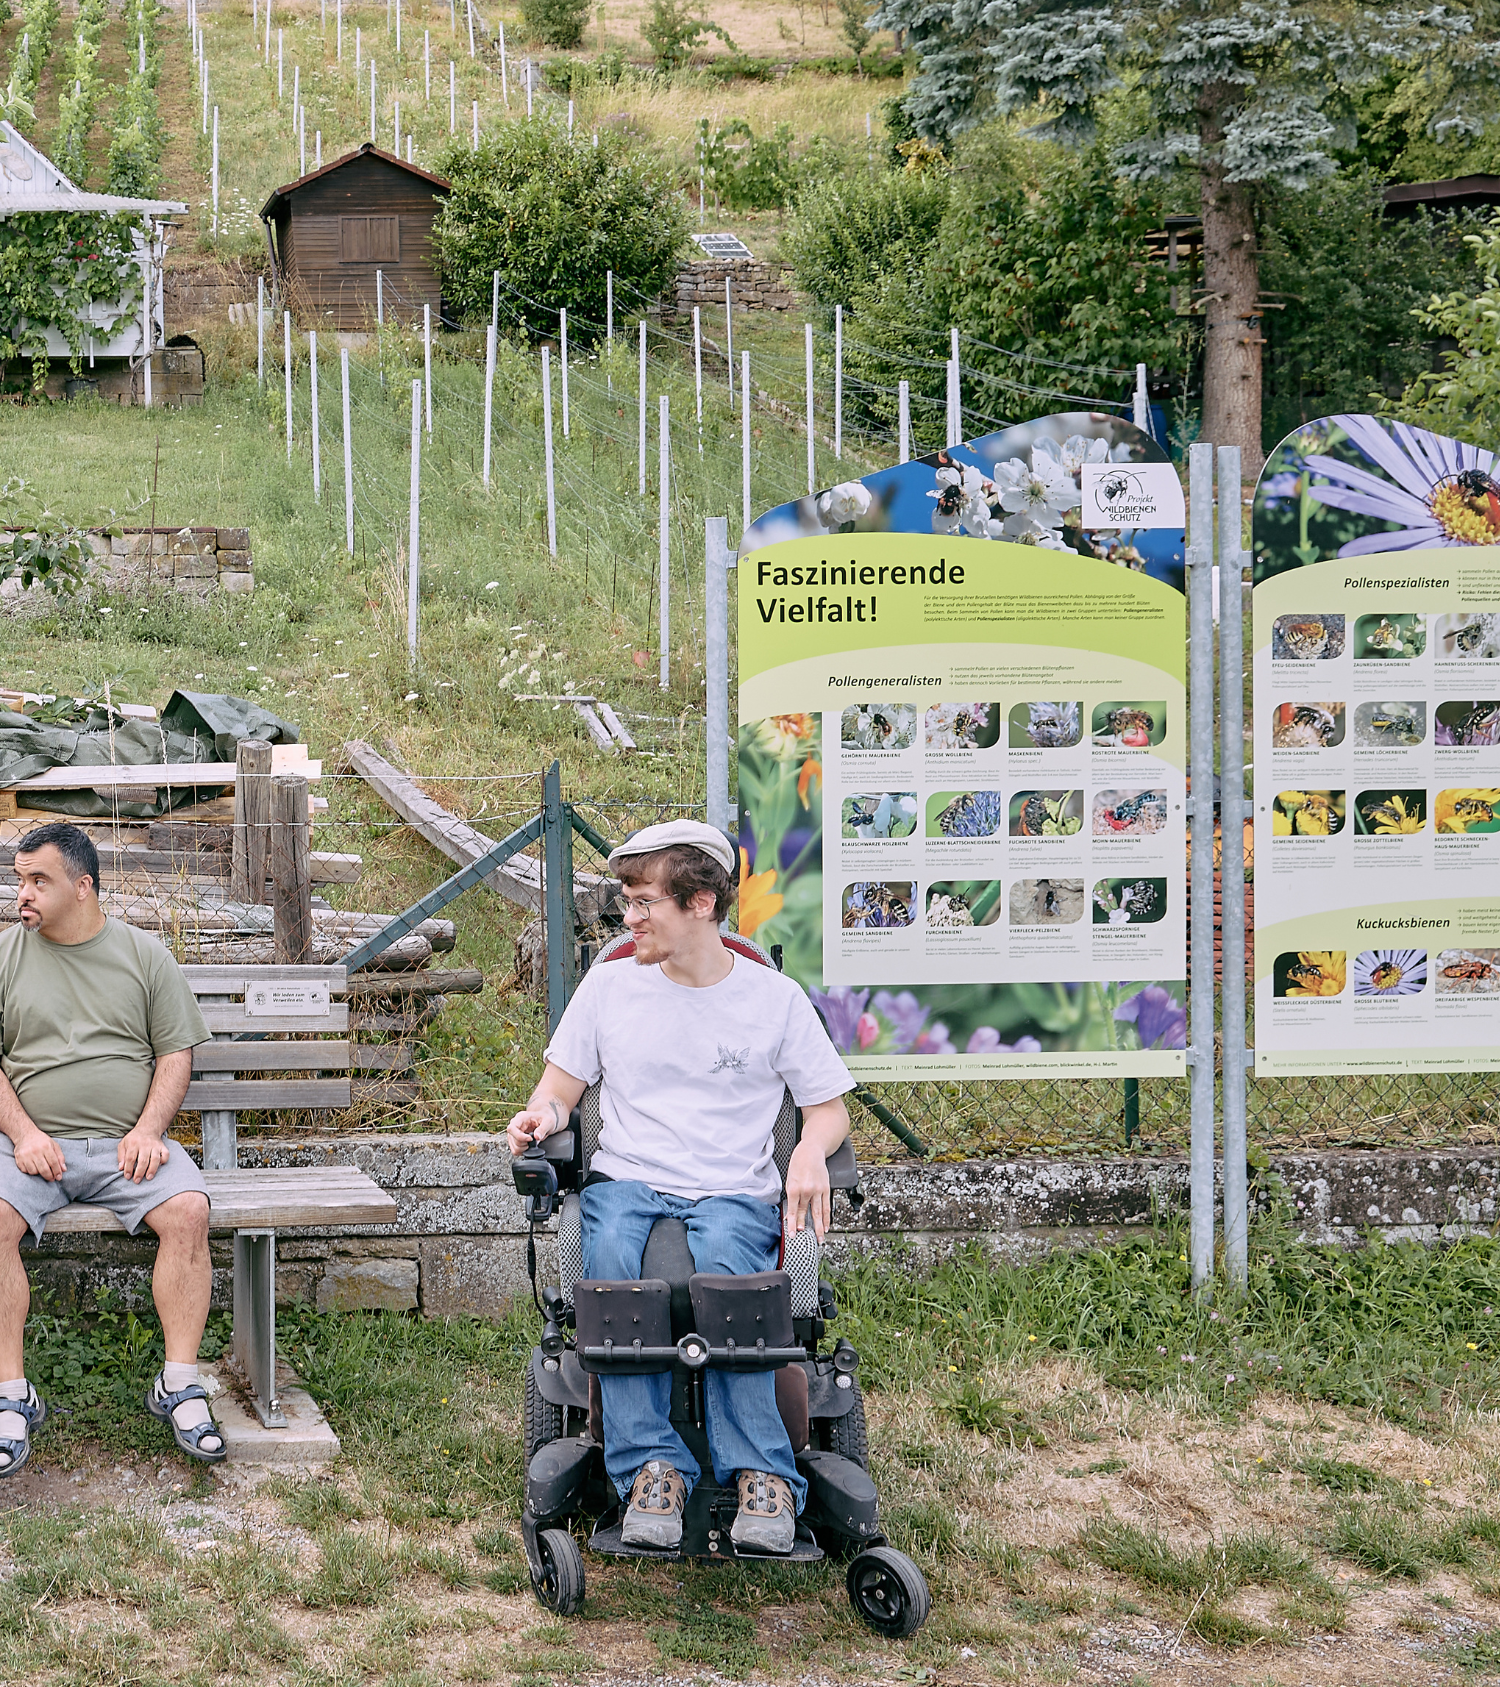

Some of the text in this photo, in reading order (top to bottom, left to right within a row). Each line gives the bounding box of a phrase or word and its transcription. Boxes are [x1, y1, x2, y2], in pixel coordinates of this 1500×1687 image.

[1127, 495, 1153, 504] Projekt
[1102, 505, 1156, 514] WILDBIENEN
[1109, 514, 1140, 522] SCHUTZ
[756, 558, 965, 586] Faszinierende
[1344, 577, 1449, 588] Pollenspezialisten
[757, 596, 876, 623] Vielfalt!
[828, 675, 942, 688] Pollengeneralisten
[1357, 917, 1450, 929] Kuckucksbienen
